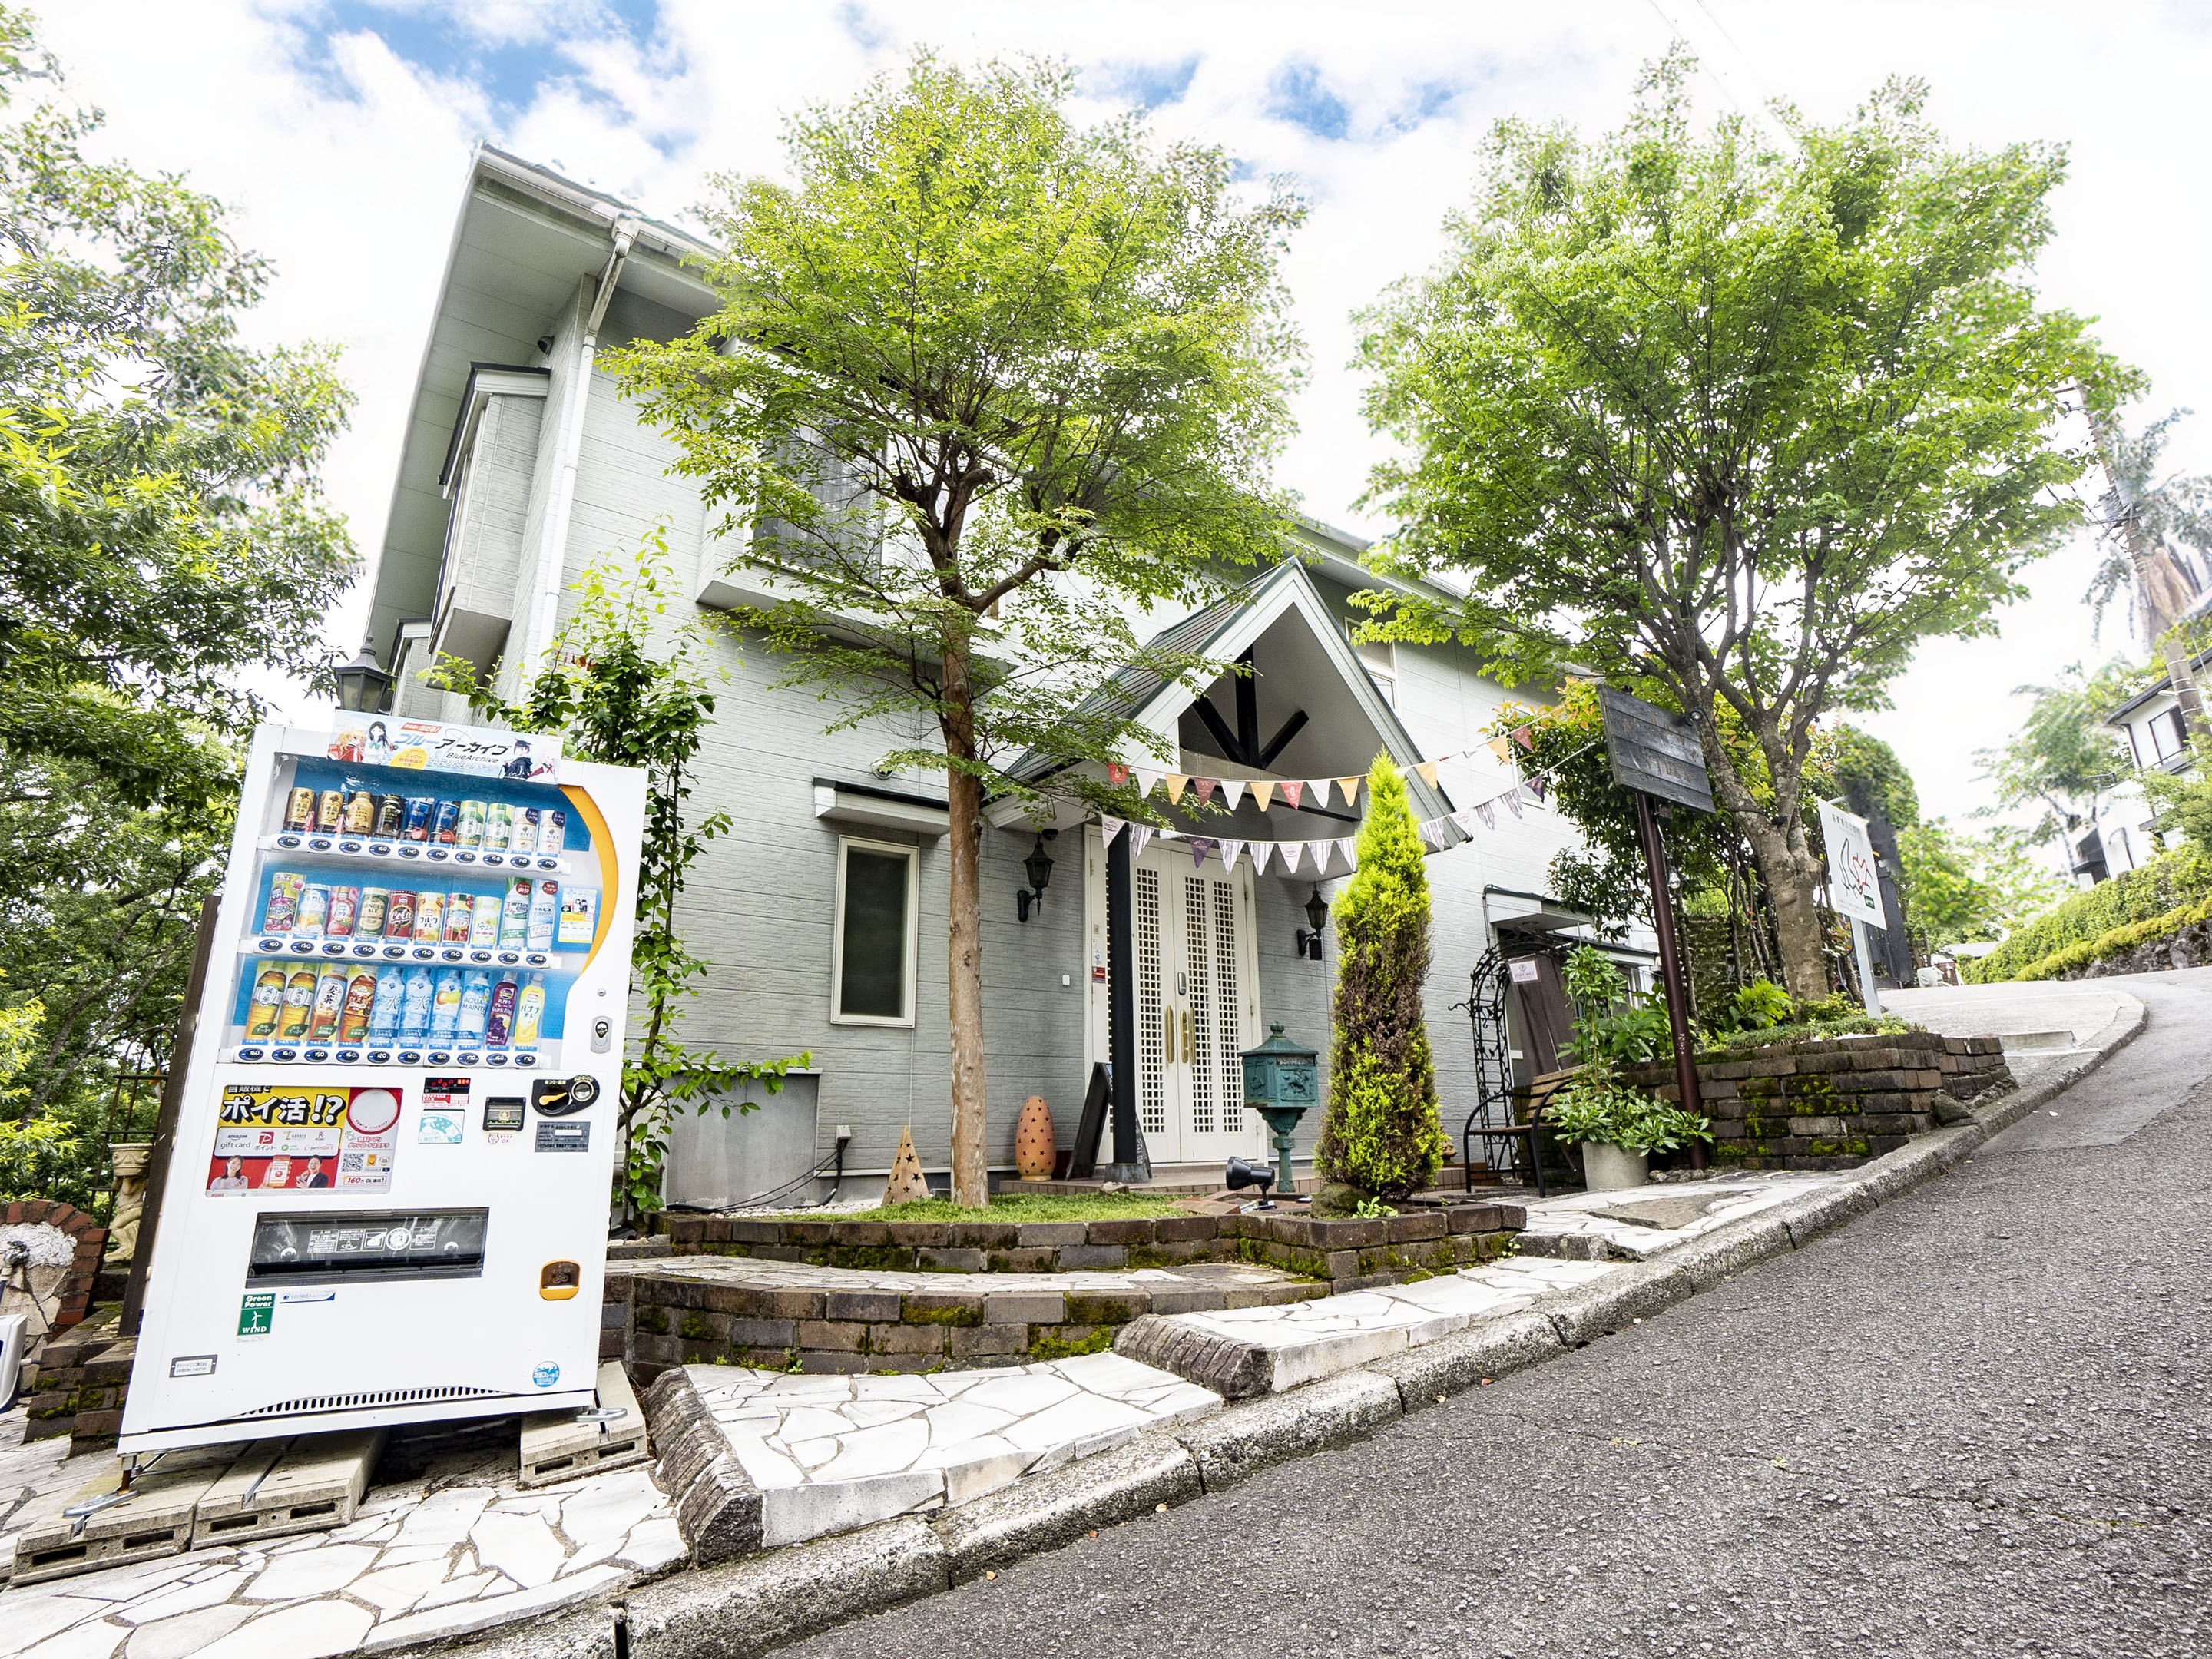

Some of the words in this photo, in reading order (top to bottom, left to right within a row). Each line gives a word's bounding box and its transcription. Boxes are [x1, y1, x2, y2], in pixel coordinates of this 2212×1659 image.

[394, 733, 512, 756] ブルーアーカイブ
[446, 753, 498, 763] BlueArchive
[391, 909, 413, 921] Cola
